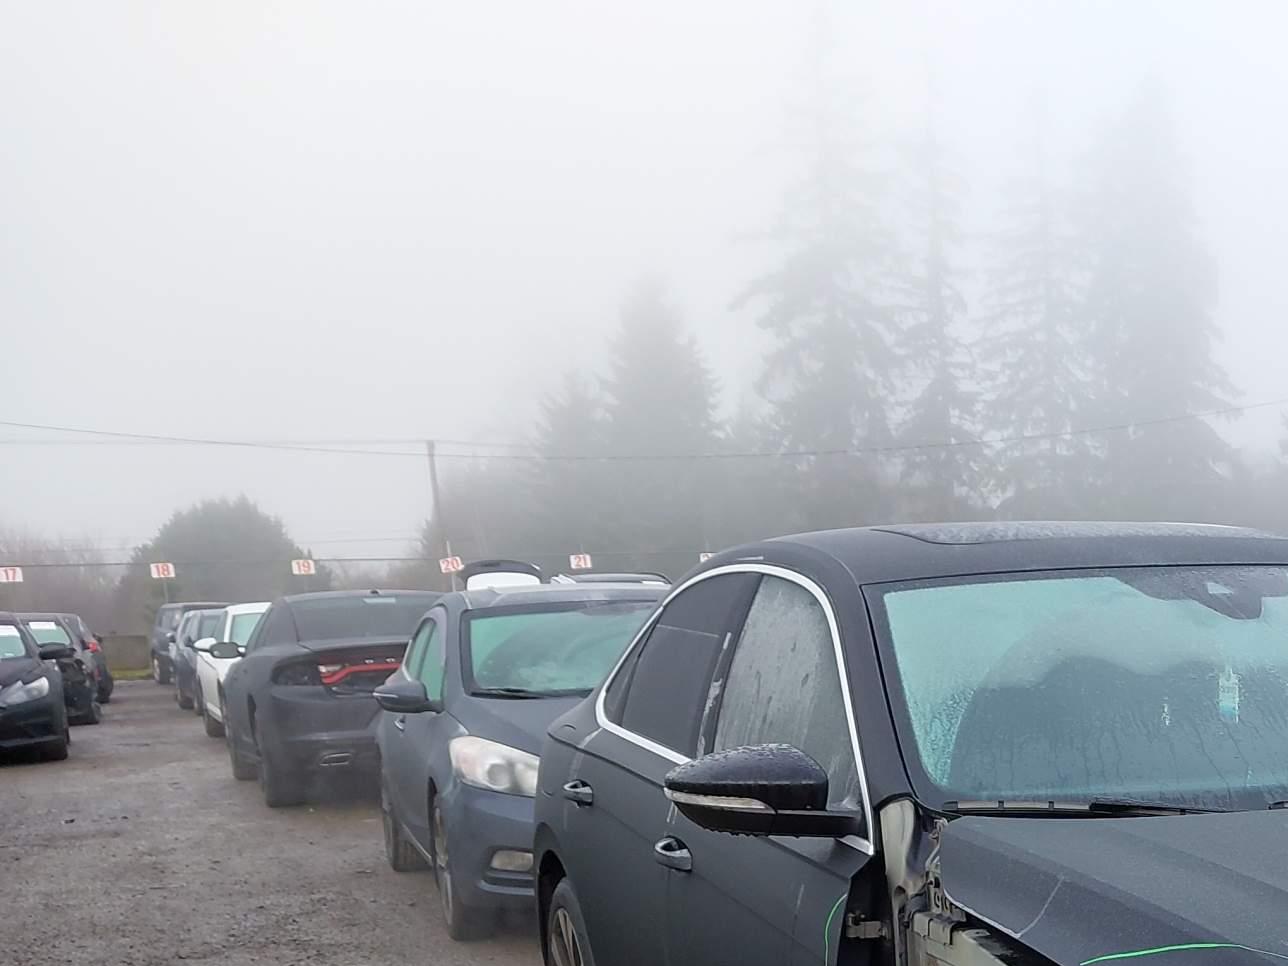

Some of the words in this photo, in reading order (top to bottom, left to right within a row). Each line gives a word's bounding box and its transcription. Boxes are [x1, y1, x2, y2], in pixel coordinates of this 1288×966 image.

[296, 561, 311, 574] 19
[442, 558, 460, 572] 20
[574, 555, 589, 568] 21
[4, 568, 17, 581] 17
[155, 564, 171, 577] 18
